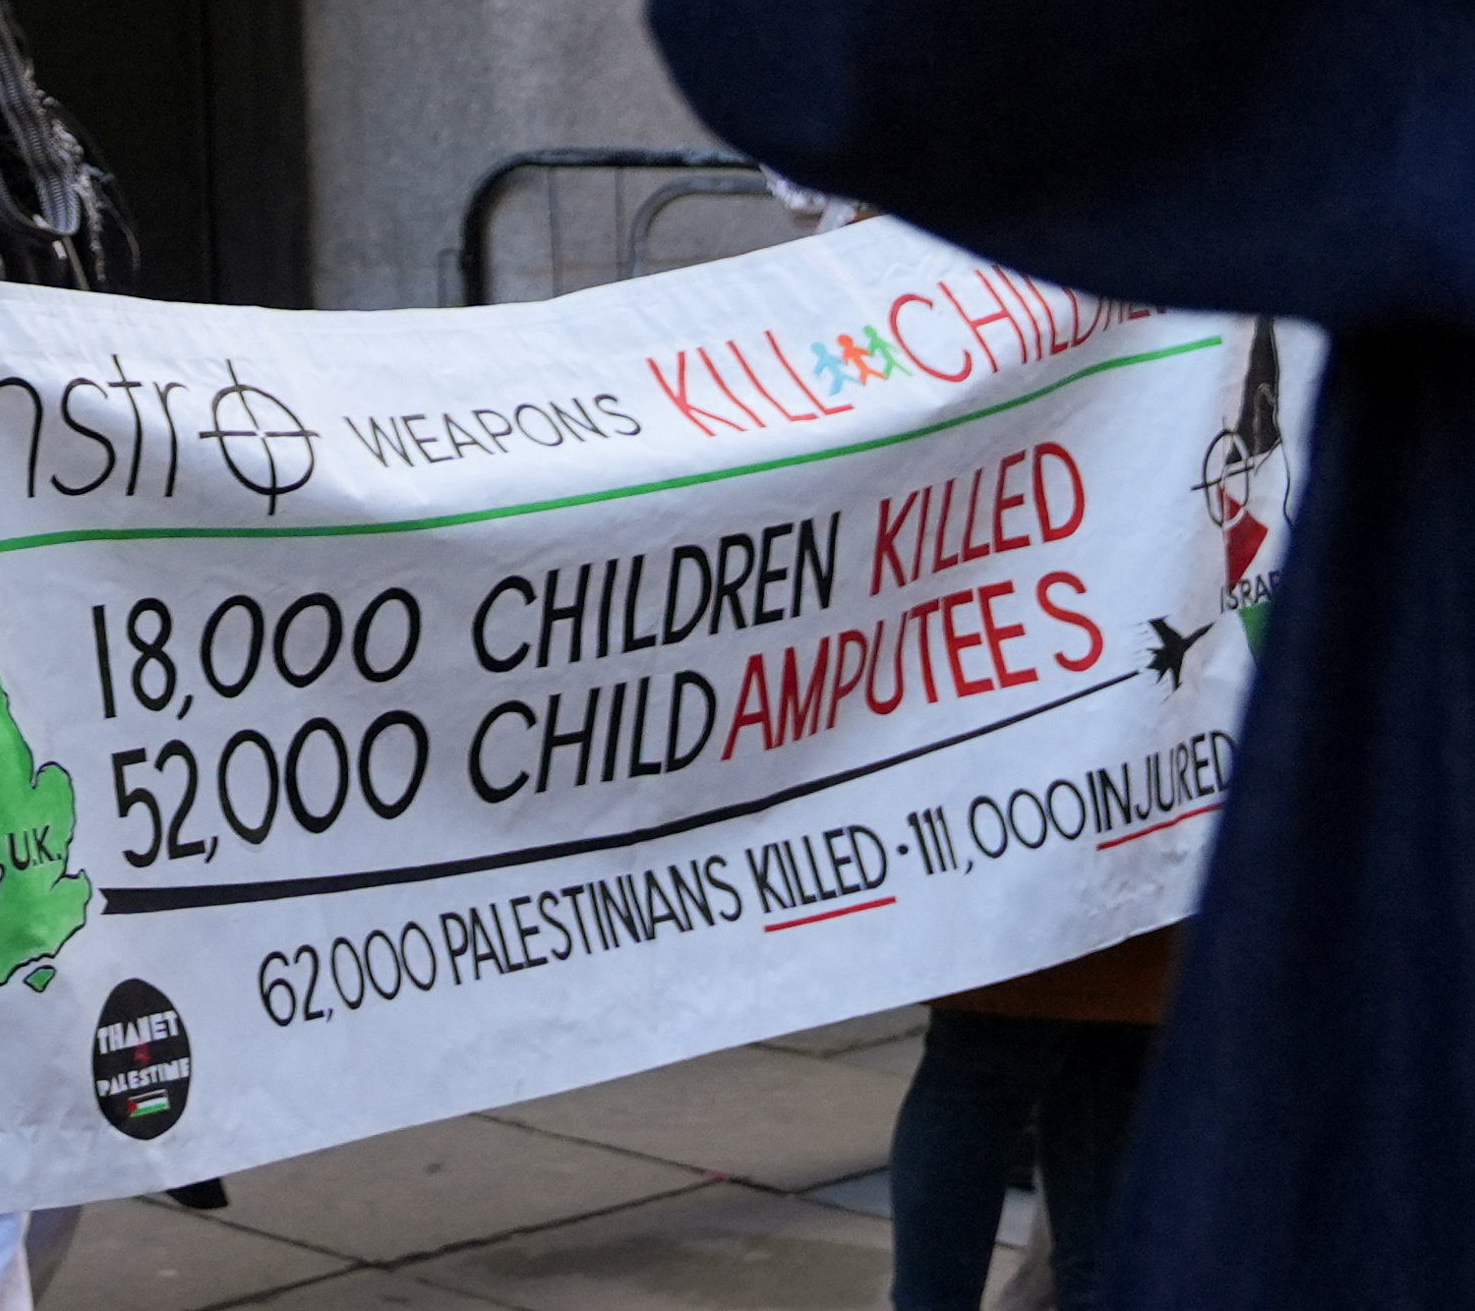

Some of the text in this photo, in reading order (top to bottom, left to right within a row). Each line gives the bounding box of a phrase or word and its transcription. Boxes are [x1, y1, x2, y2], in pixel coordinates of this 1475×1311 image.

[345, 393, 642, 468] WEAPONS
[646, 329, 853, 436] KILL
[888, 264, 1167, 382] CHILD
[91, 441, 1085, 720] 18,000 CHILDREN KILLED
[111, 571, 1103, 867] 52,000 CHILD AMPUTEES
[9, 825, 62, 870] U.K.
[258, 730, 1238, 1027] 62,000 PALESTINIANS KILLED 111,000 INJURED
[96, 1057, 190, 1097] PALESTINE
[97, 1010, 178, 1055] THANET
